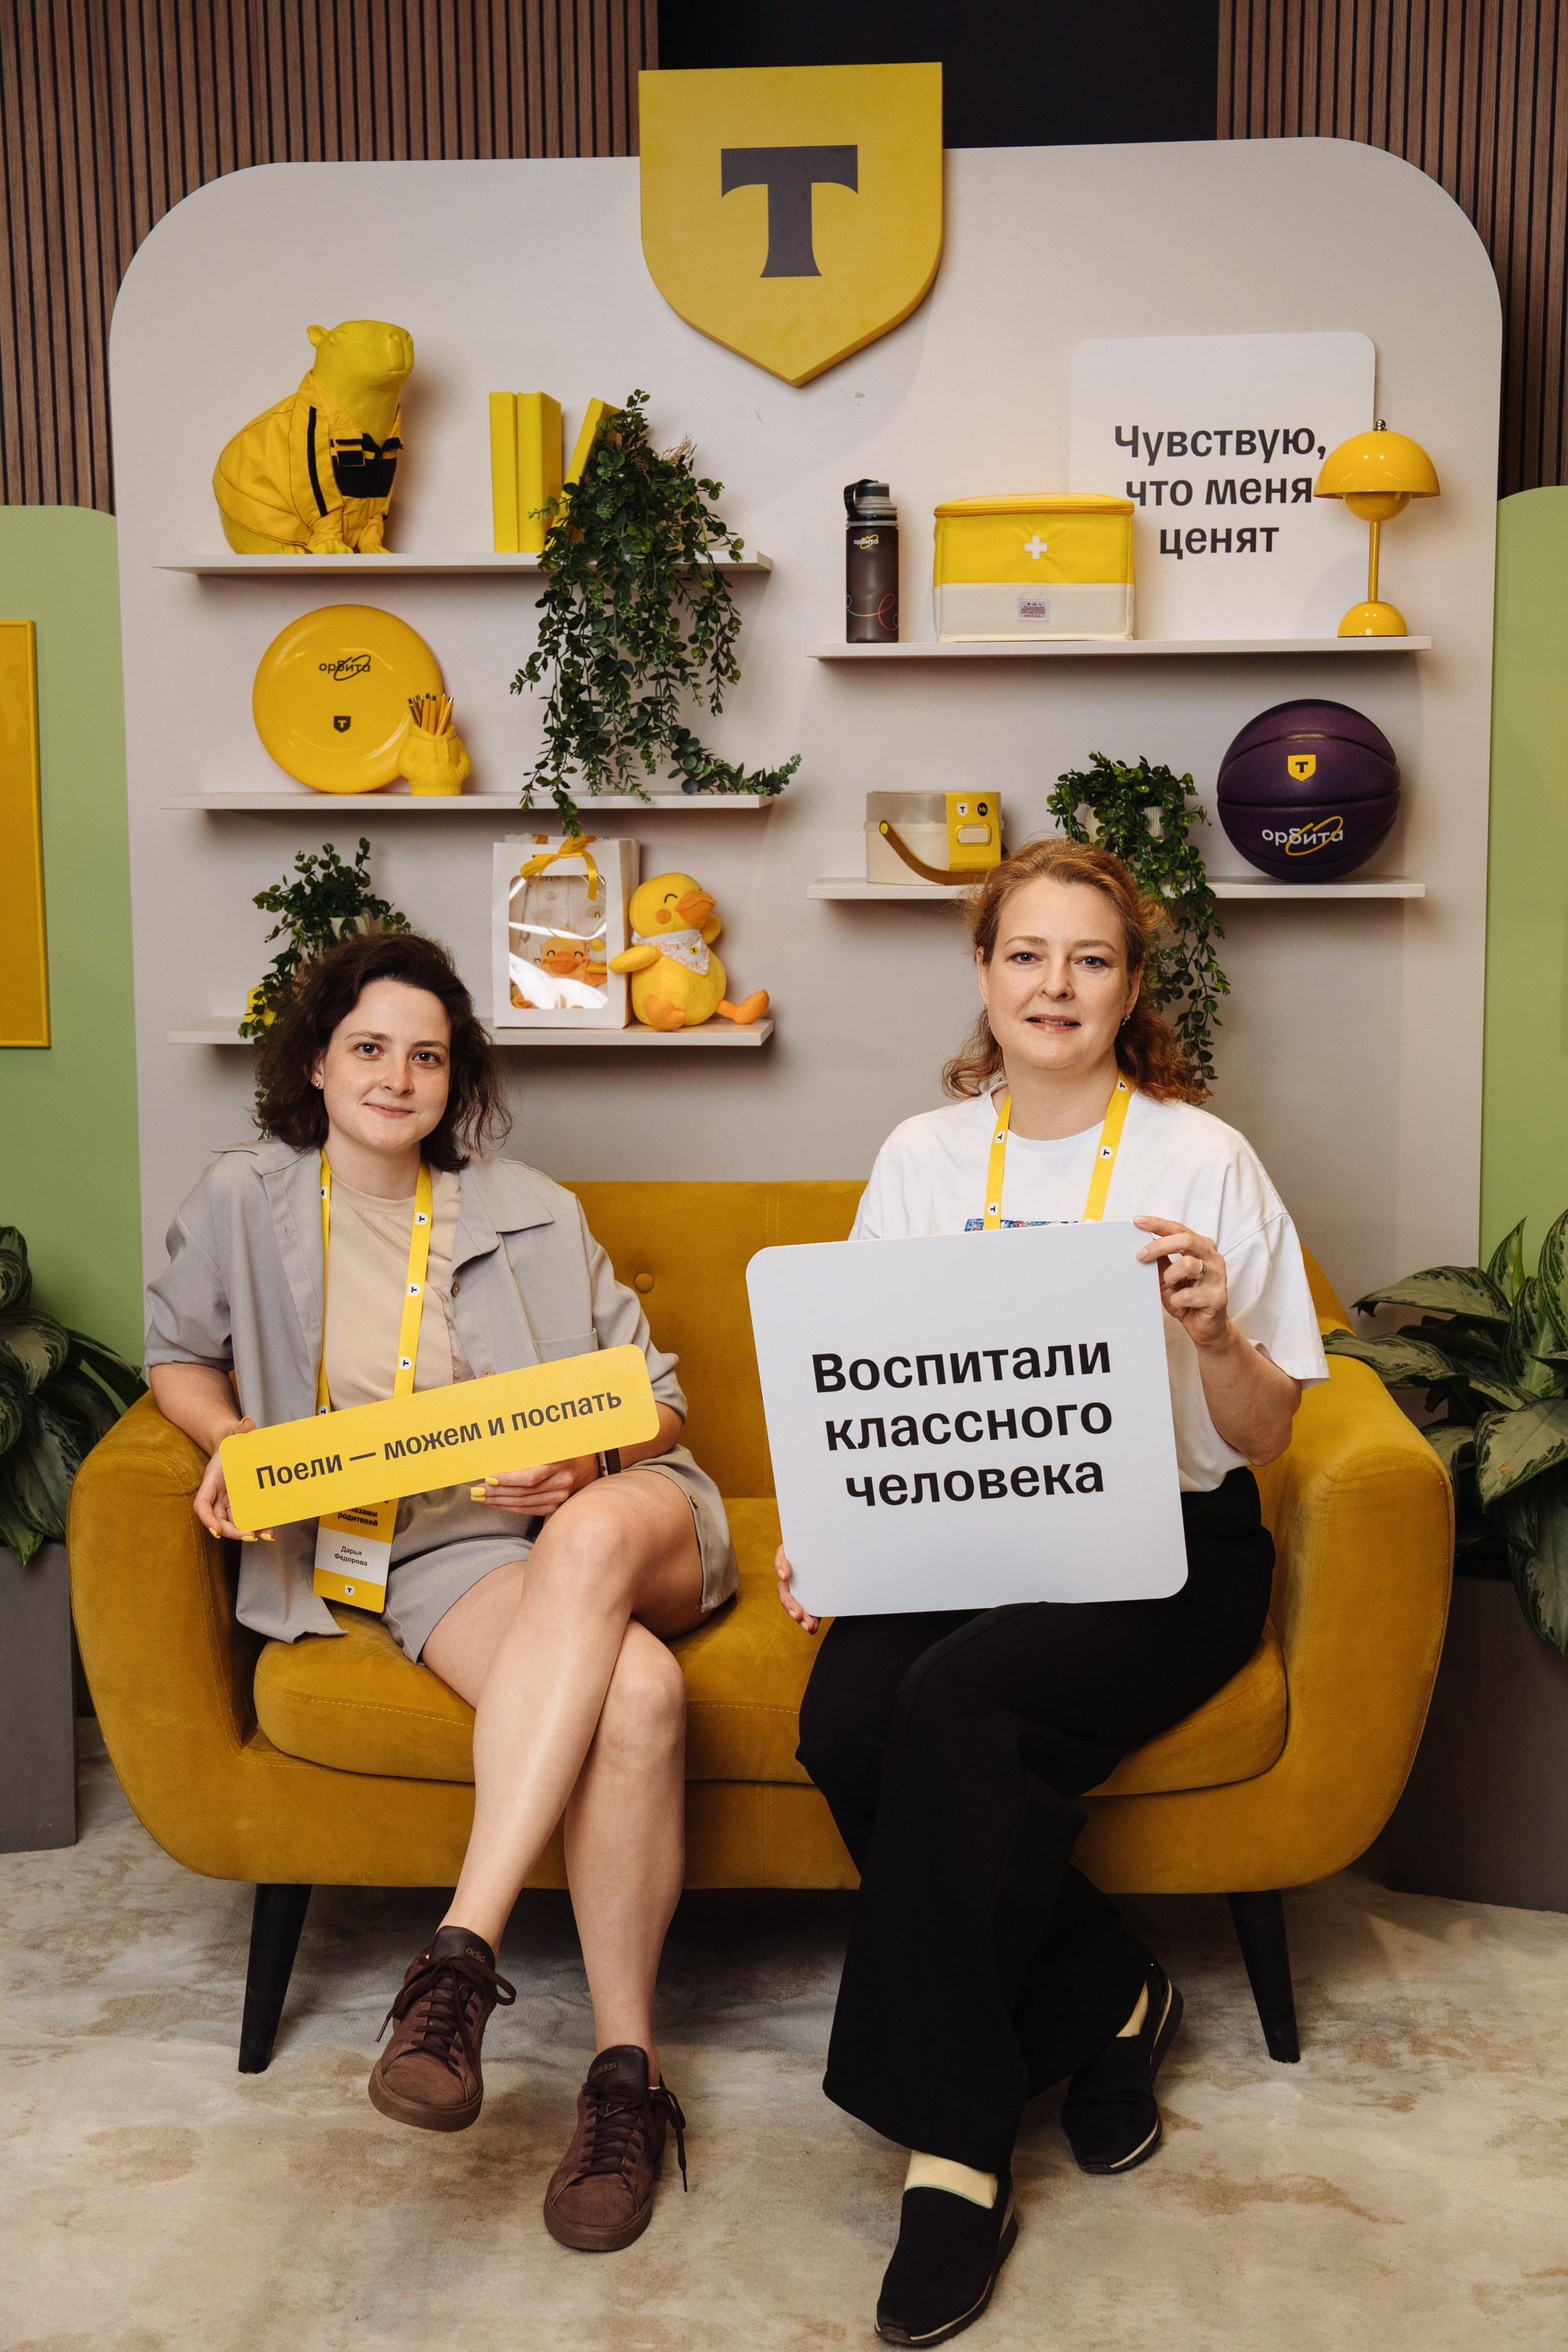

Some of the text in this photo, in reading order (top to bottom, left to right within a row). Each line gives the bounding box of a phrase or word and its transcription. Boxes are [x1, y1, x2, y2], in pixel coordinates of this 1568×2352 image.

[1114, 425, 1327, 466] Чувствую,
[1126, 477, 1312, 506] что меня
[1160, 527, 1279, 560] ценят
[811, 1341, 1112, 1393] Воспитали
[256, 1454, 343, 1489] Поели
[383, 1422, 481, 1461] можем
[489, 1416, 506, 1436] и
[511, 1392, 622, 1431] поспать
[825, 1402, 1112, 1451] классного
[845, 1461, 1105, 1507] человека
[337, 1512, 379, 1527] родителей
[346, 1506, 378, 1518] лазами
[334, 1553, 368, 1566] Федорова
[341, 1545, 362, 1556] Дарья
[593, 2062, 617, 2078] adidas
